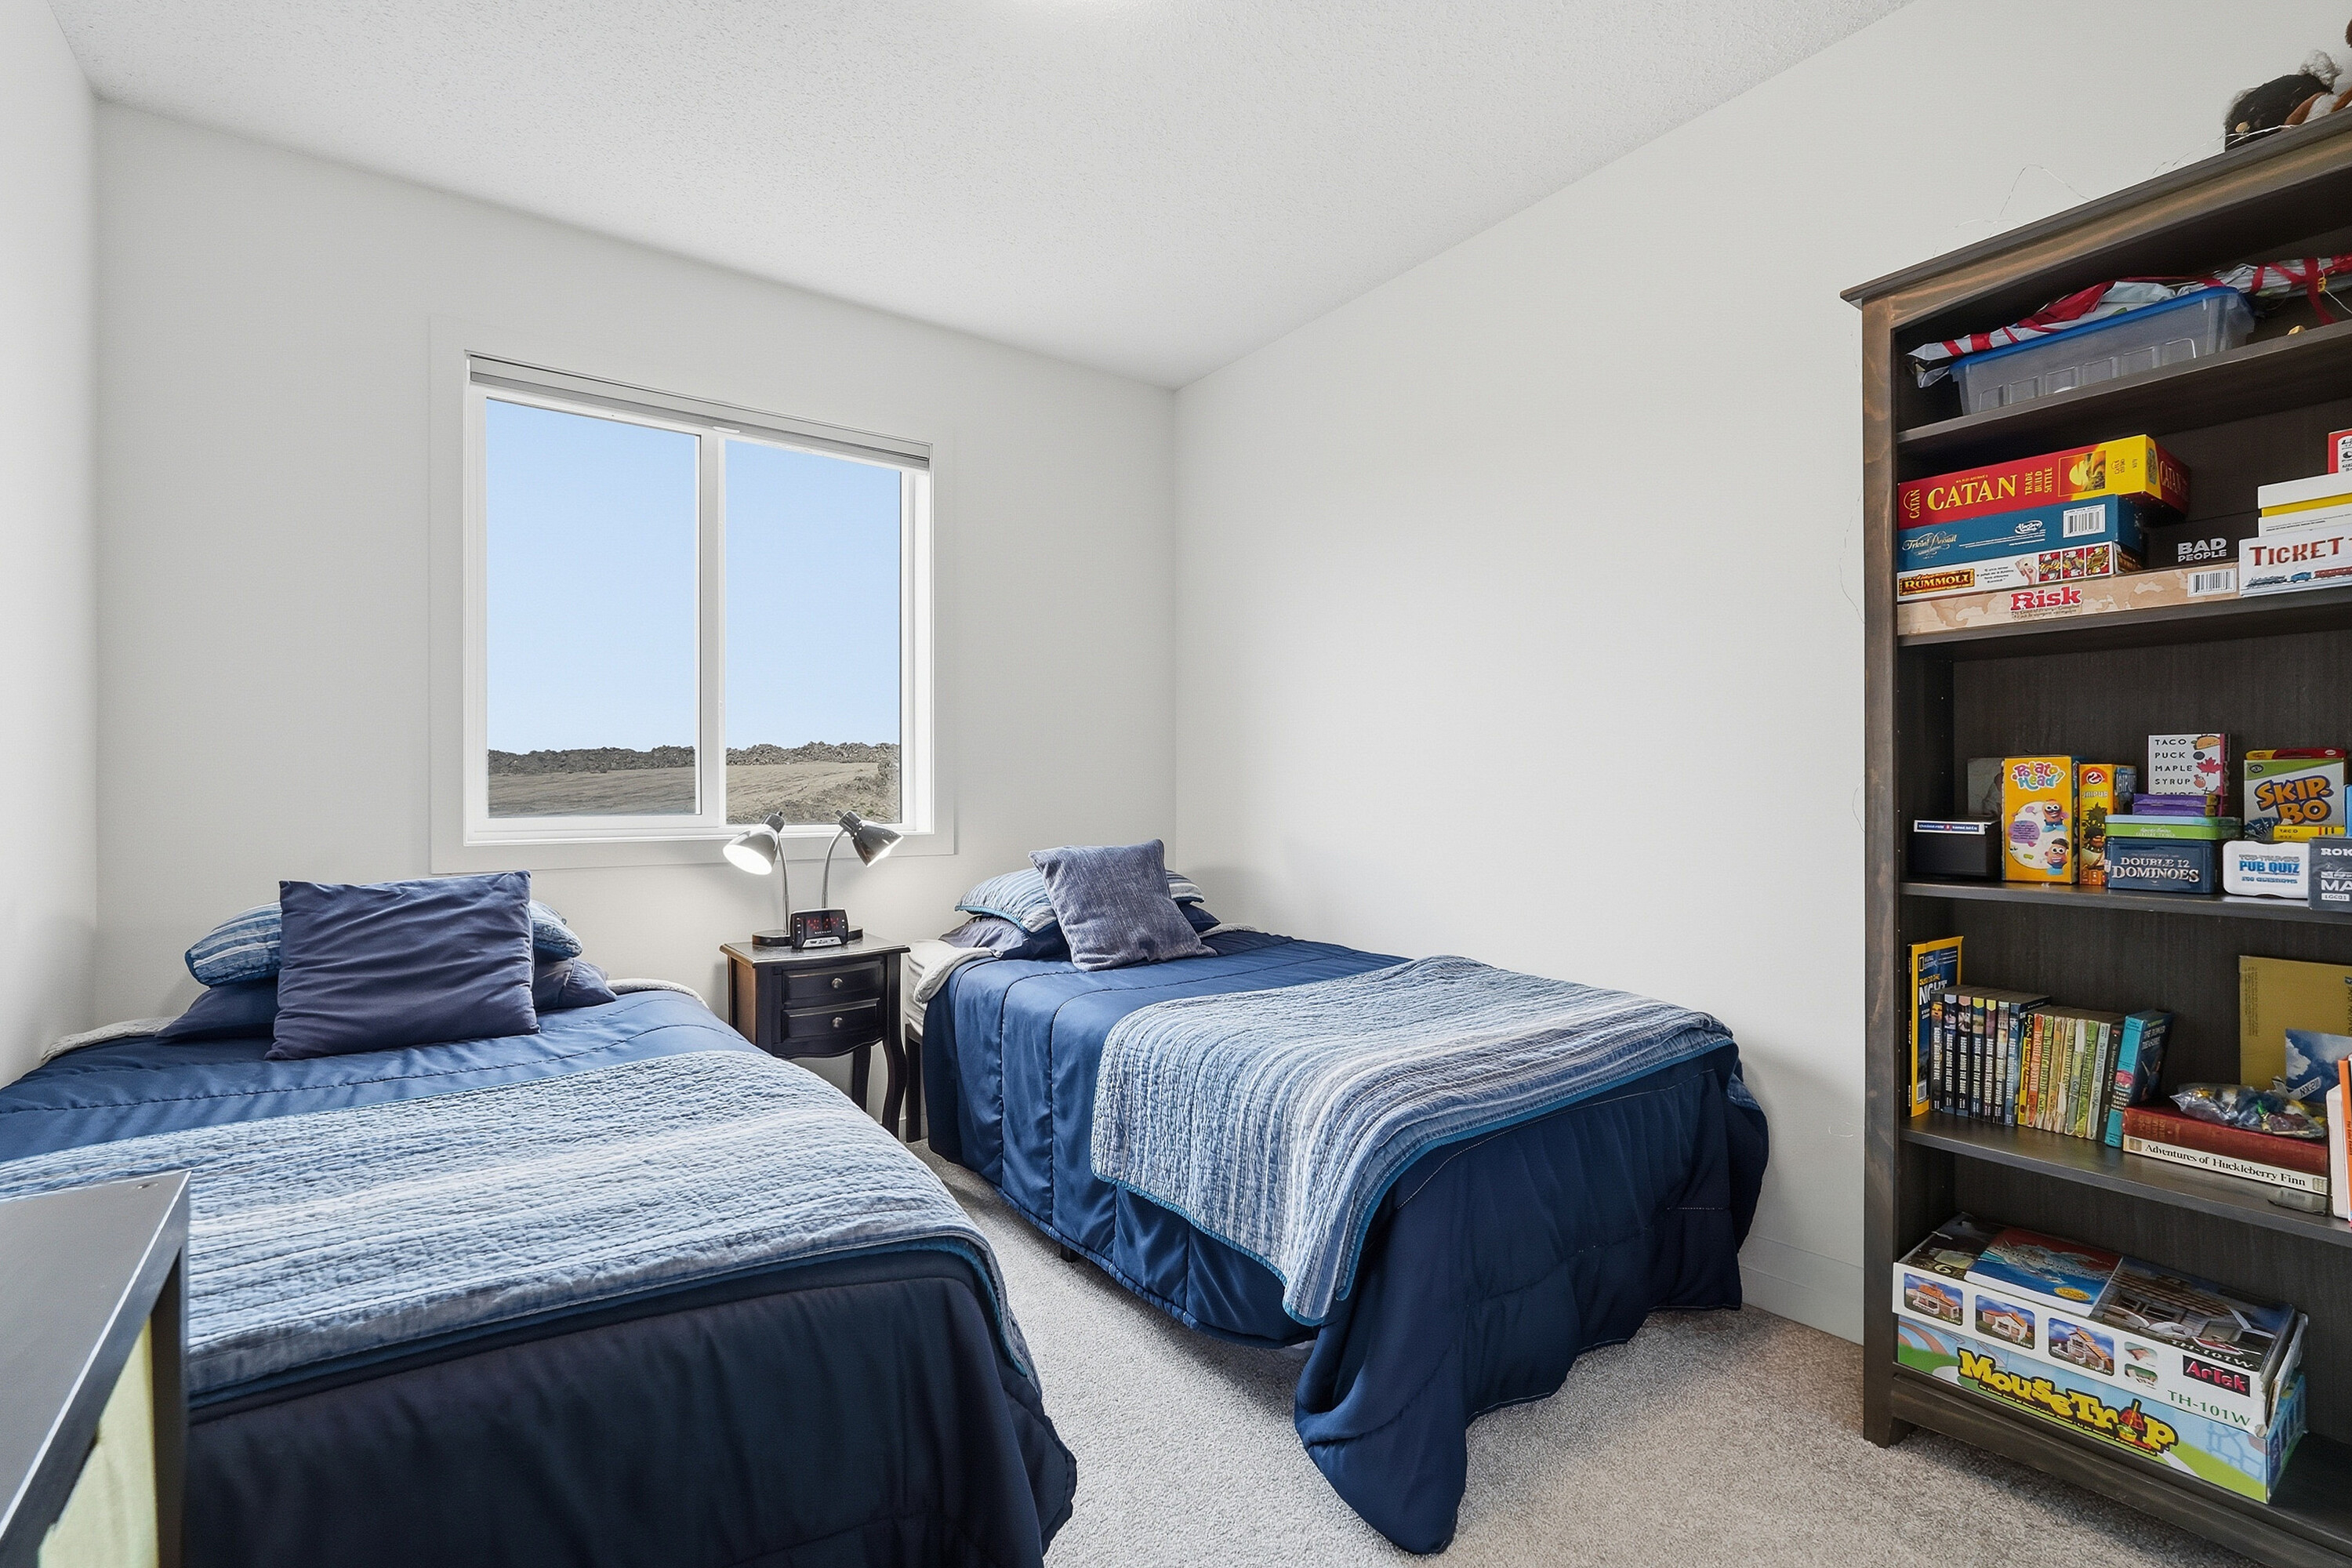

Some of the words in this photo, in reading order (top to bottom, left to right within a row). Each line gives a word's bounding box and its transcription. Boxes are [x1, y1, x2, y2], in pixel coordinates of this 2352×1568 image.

[1927, 474, 2017, 510] CATAN
[1904, 489, 1920, 519] CATAN
[2178, 538, 2227, 555] BAD
[2178, 550, 2227, 562] PEOPLE
[2249, 537, 2344, 566] TICKET
[1904, 575, 1969, 589] RUMMOLI
[2010, 586, 2082, 610] Risk
[2014, 762, 2059, 777] Potato
[2017, 775, 2056, 790] Head
[2278, 800, 2330, 823] BO
[2121, 857, 2174, 867] DOUBLE
[2177, 859, 2190, 868] 12
[2240, 861, 2265, 872] PUB
[2269, 862, 2299, 875] QUIZ
[2111, 866, 2200, 883] DOMINOES
[2145, 1144, 2197, 1162] Adventures
[2212, 1158, 2278, 1181] Huckleberry
[2280, 1173, 2306, 1186] Finn
[2170, 1338, 2254, 1367] TH-101W
[2185, 1360, 2247, 1392] ArTek
[2168, 1389, 2252, 1426] TH-101W
